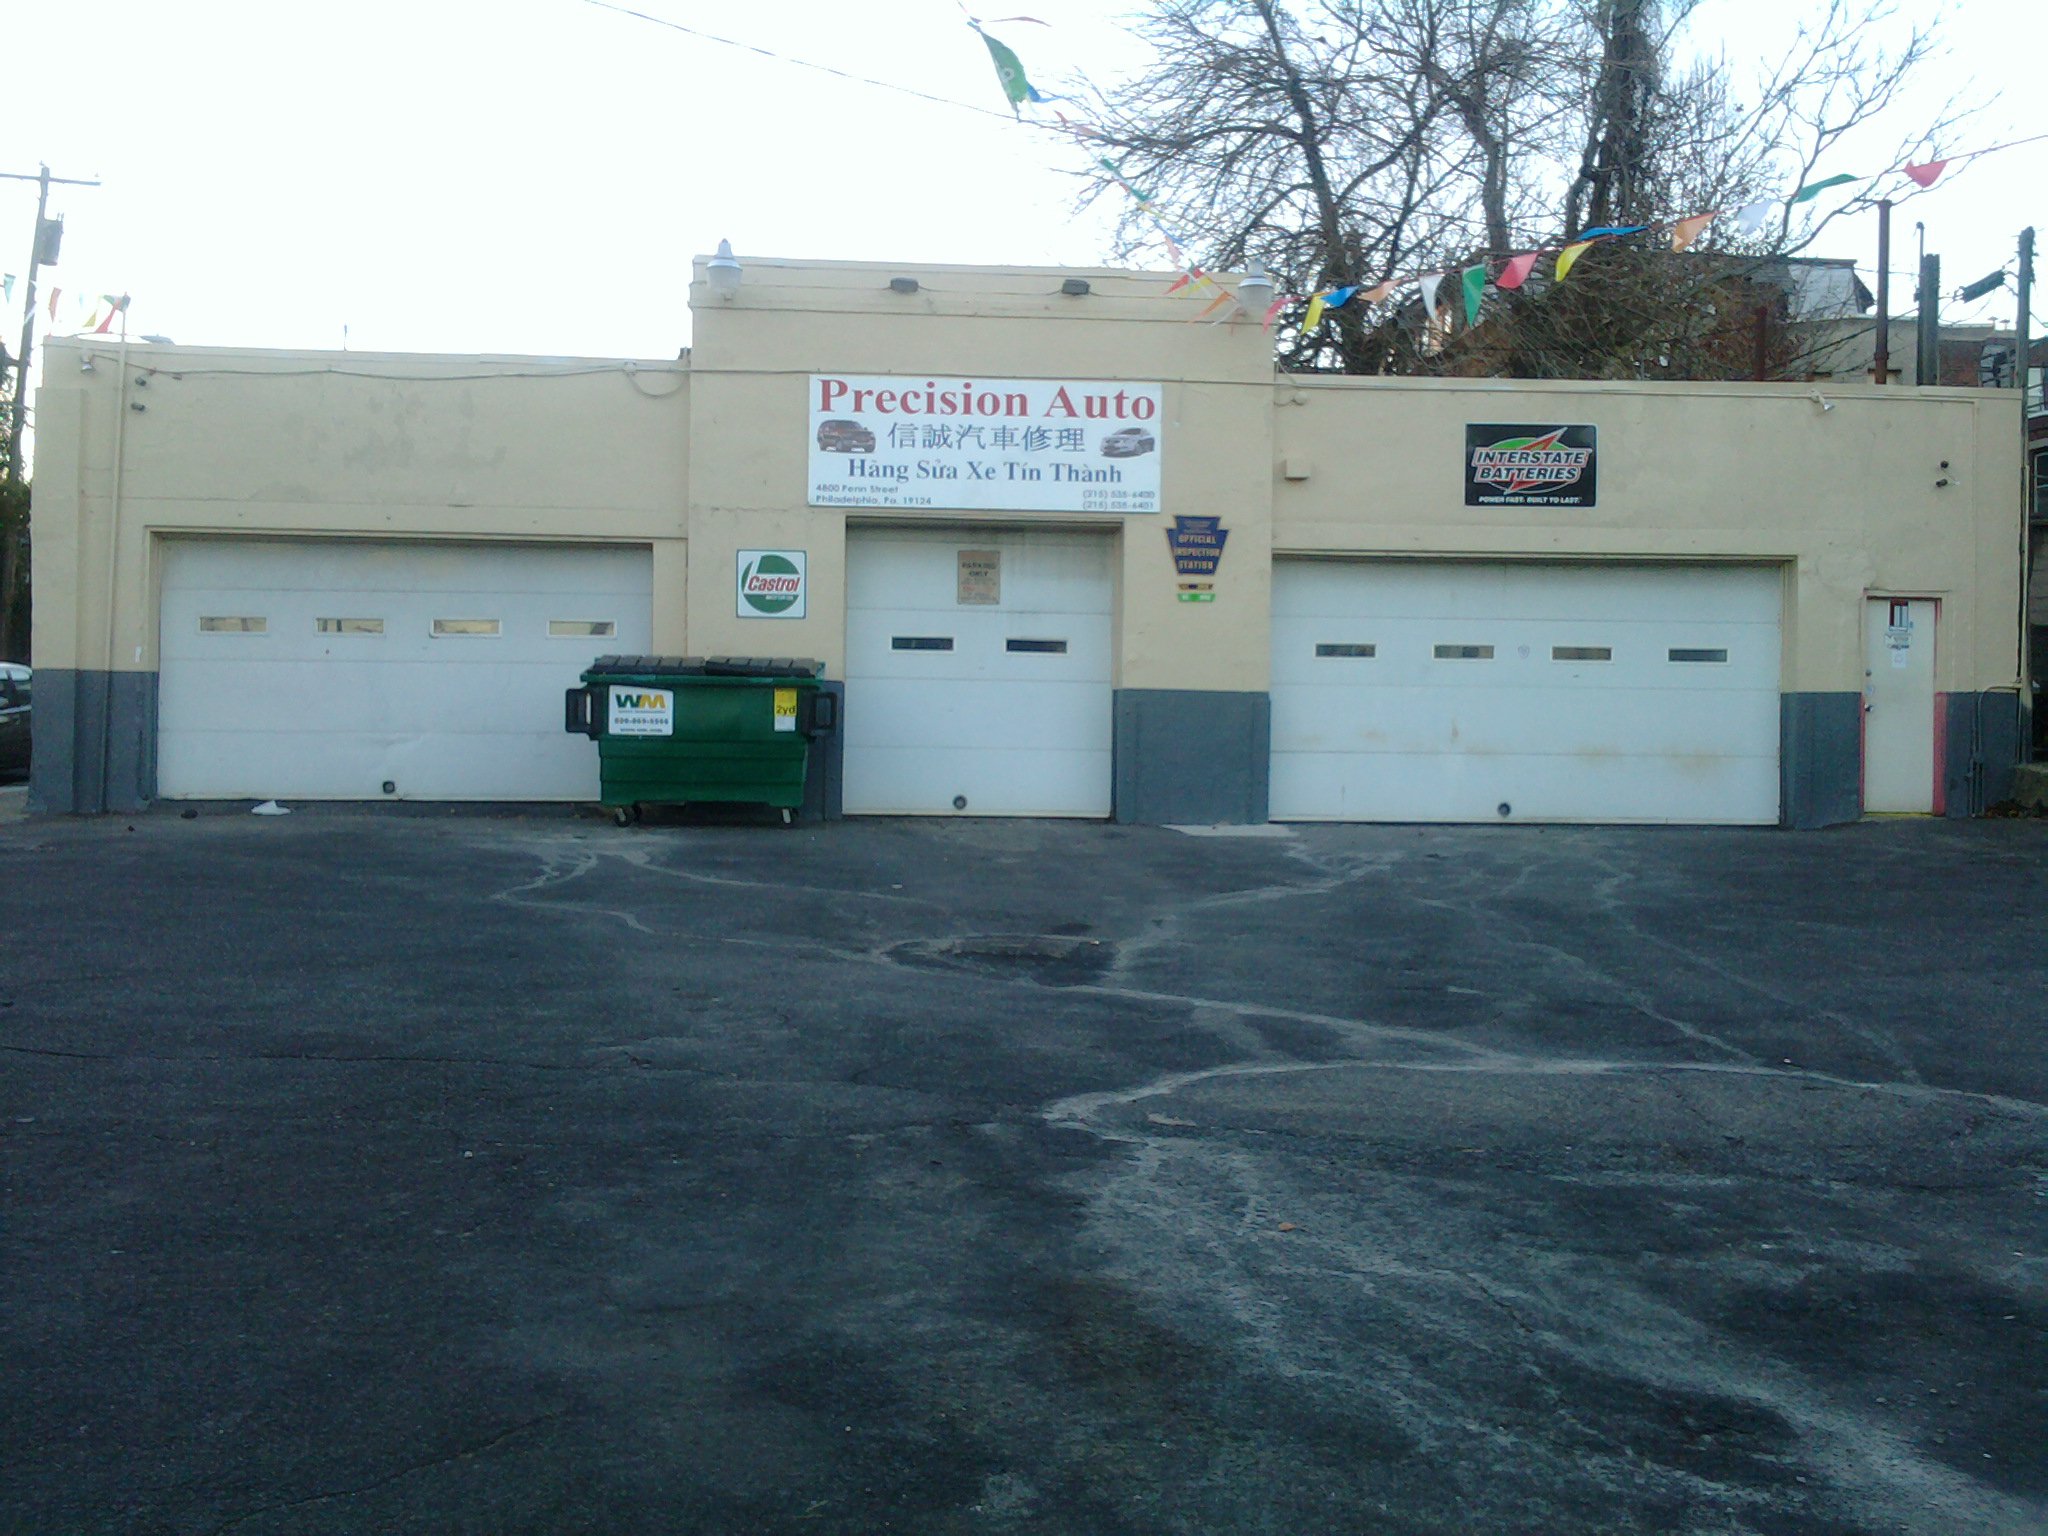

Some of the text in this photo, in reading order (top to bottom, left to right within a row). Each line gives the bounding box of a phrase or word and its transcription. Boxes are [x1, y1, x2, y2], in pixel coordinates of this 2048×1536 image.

[817, 379, 1156, 421] Precision Auto
[888, 421, 1086, 452] 信誠汽車修理
[1477, 450, 1586, 464] INTERSTATE
[966, 461, 997, 481] Xe
[1050, 462, 1122, 483] Thành
[1480, 467, 1577, 480] BATTERIES
[815, 484, 840, 493] 4800
[870, 485, 899, 494] Street
[903, 496, 932, 505] 19124
[1549, 496, 1560, 504] TO
[1177, 534, 1217, 544] OFFICIAL
[1178, 560, 1214, 569] STATION
[747, 575, 801, 592] Castrol
[615, 693, 666, 709] WM
[776, 704, 796, 715] 2yd
